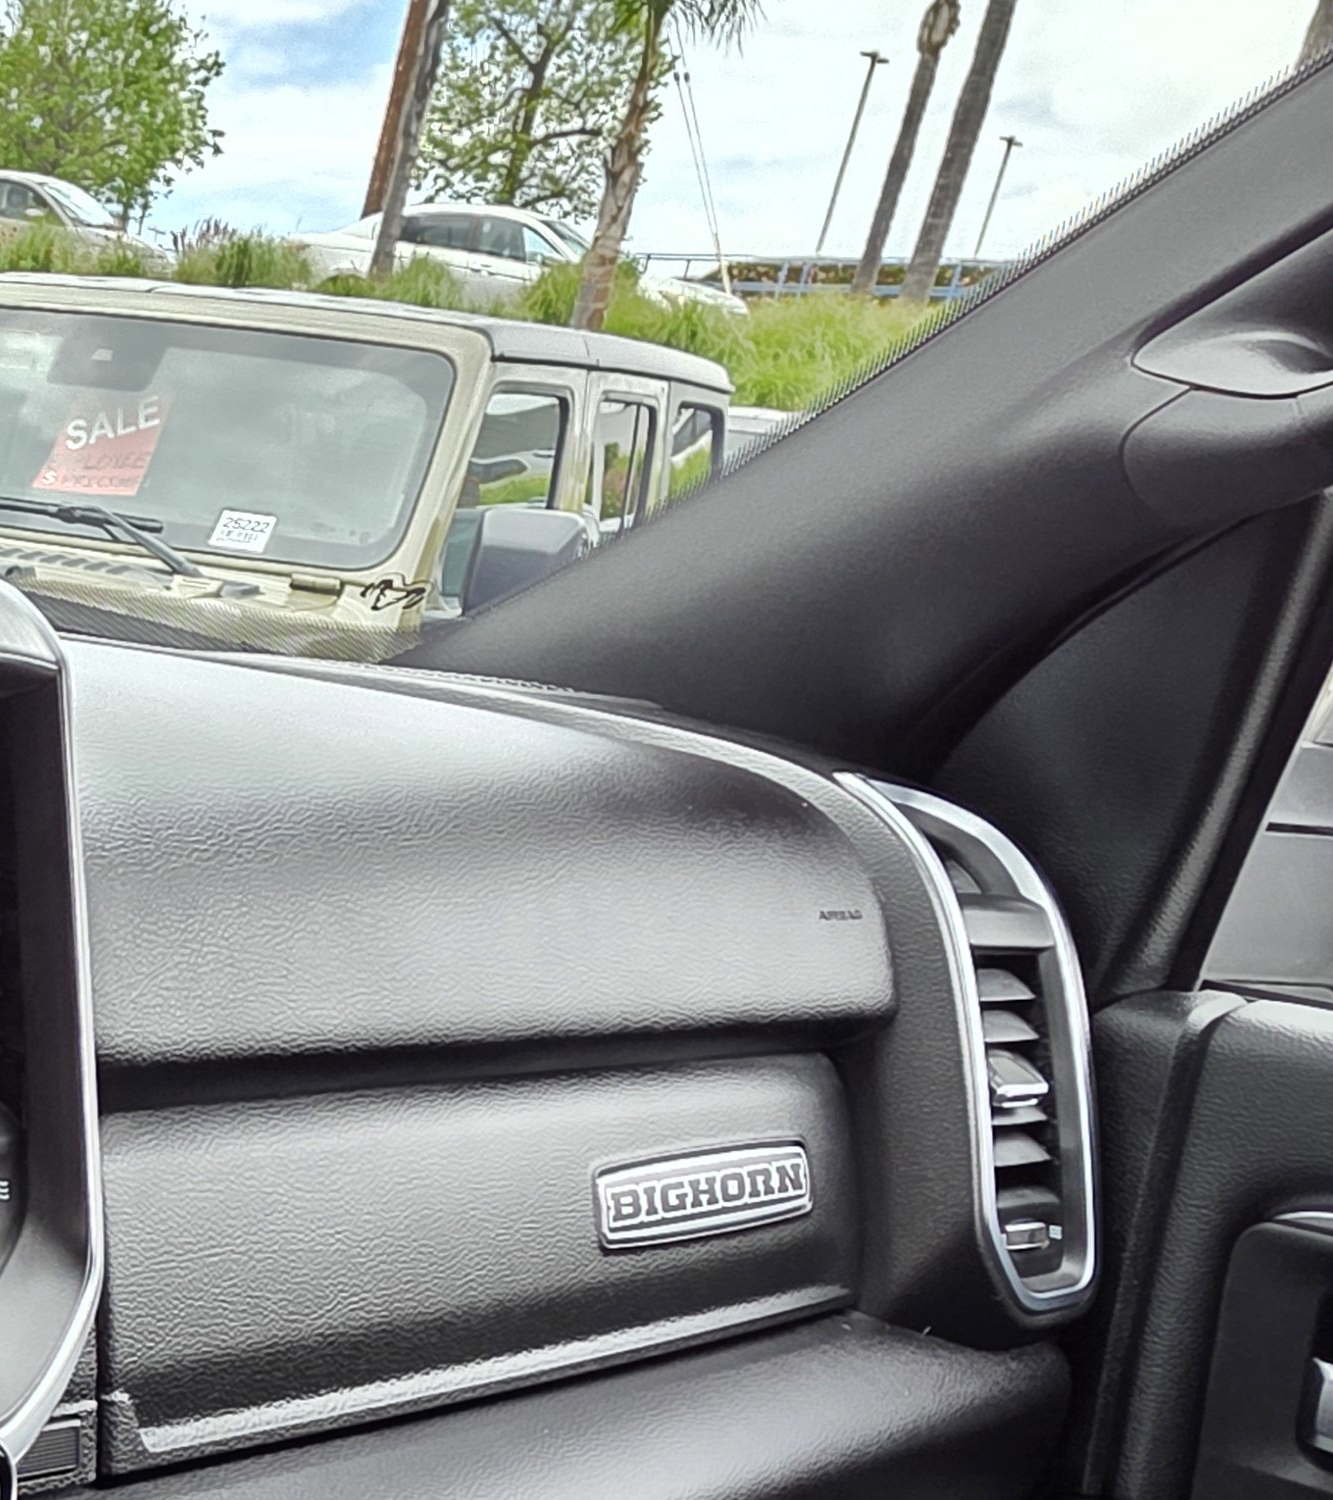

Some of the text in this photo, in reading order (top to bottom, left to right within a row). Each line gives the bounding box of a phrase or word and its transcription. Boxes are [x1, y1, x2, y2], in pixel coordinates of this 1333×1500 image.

[65, 396, 161, 450] SALE
[221, 516, 270, 534] 25222
[610, 1162, 804, 1222] BIGHORN
